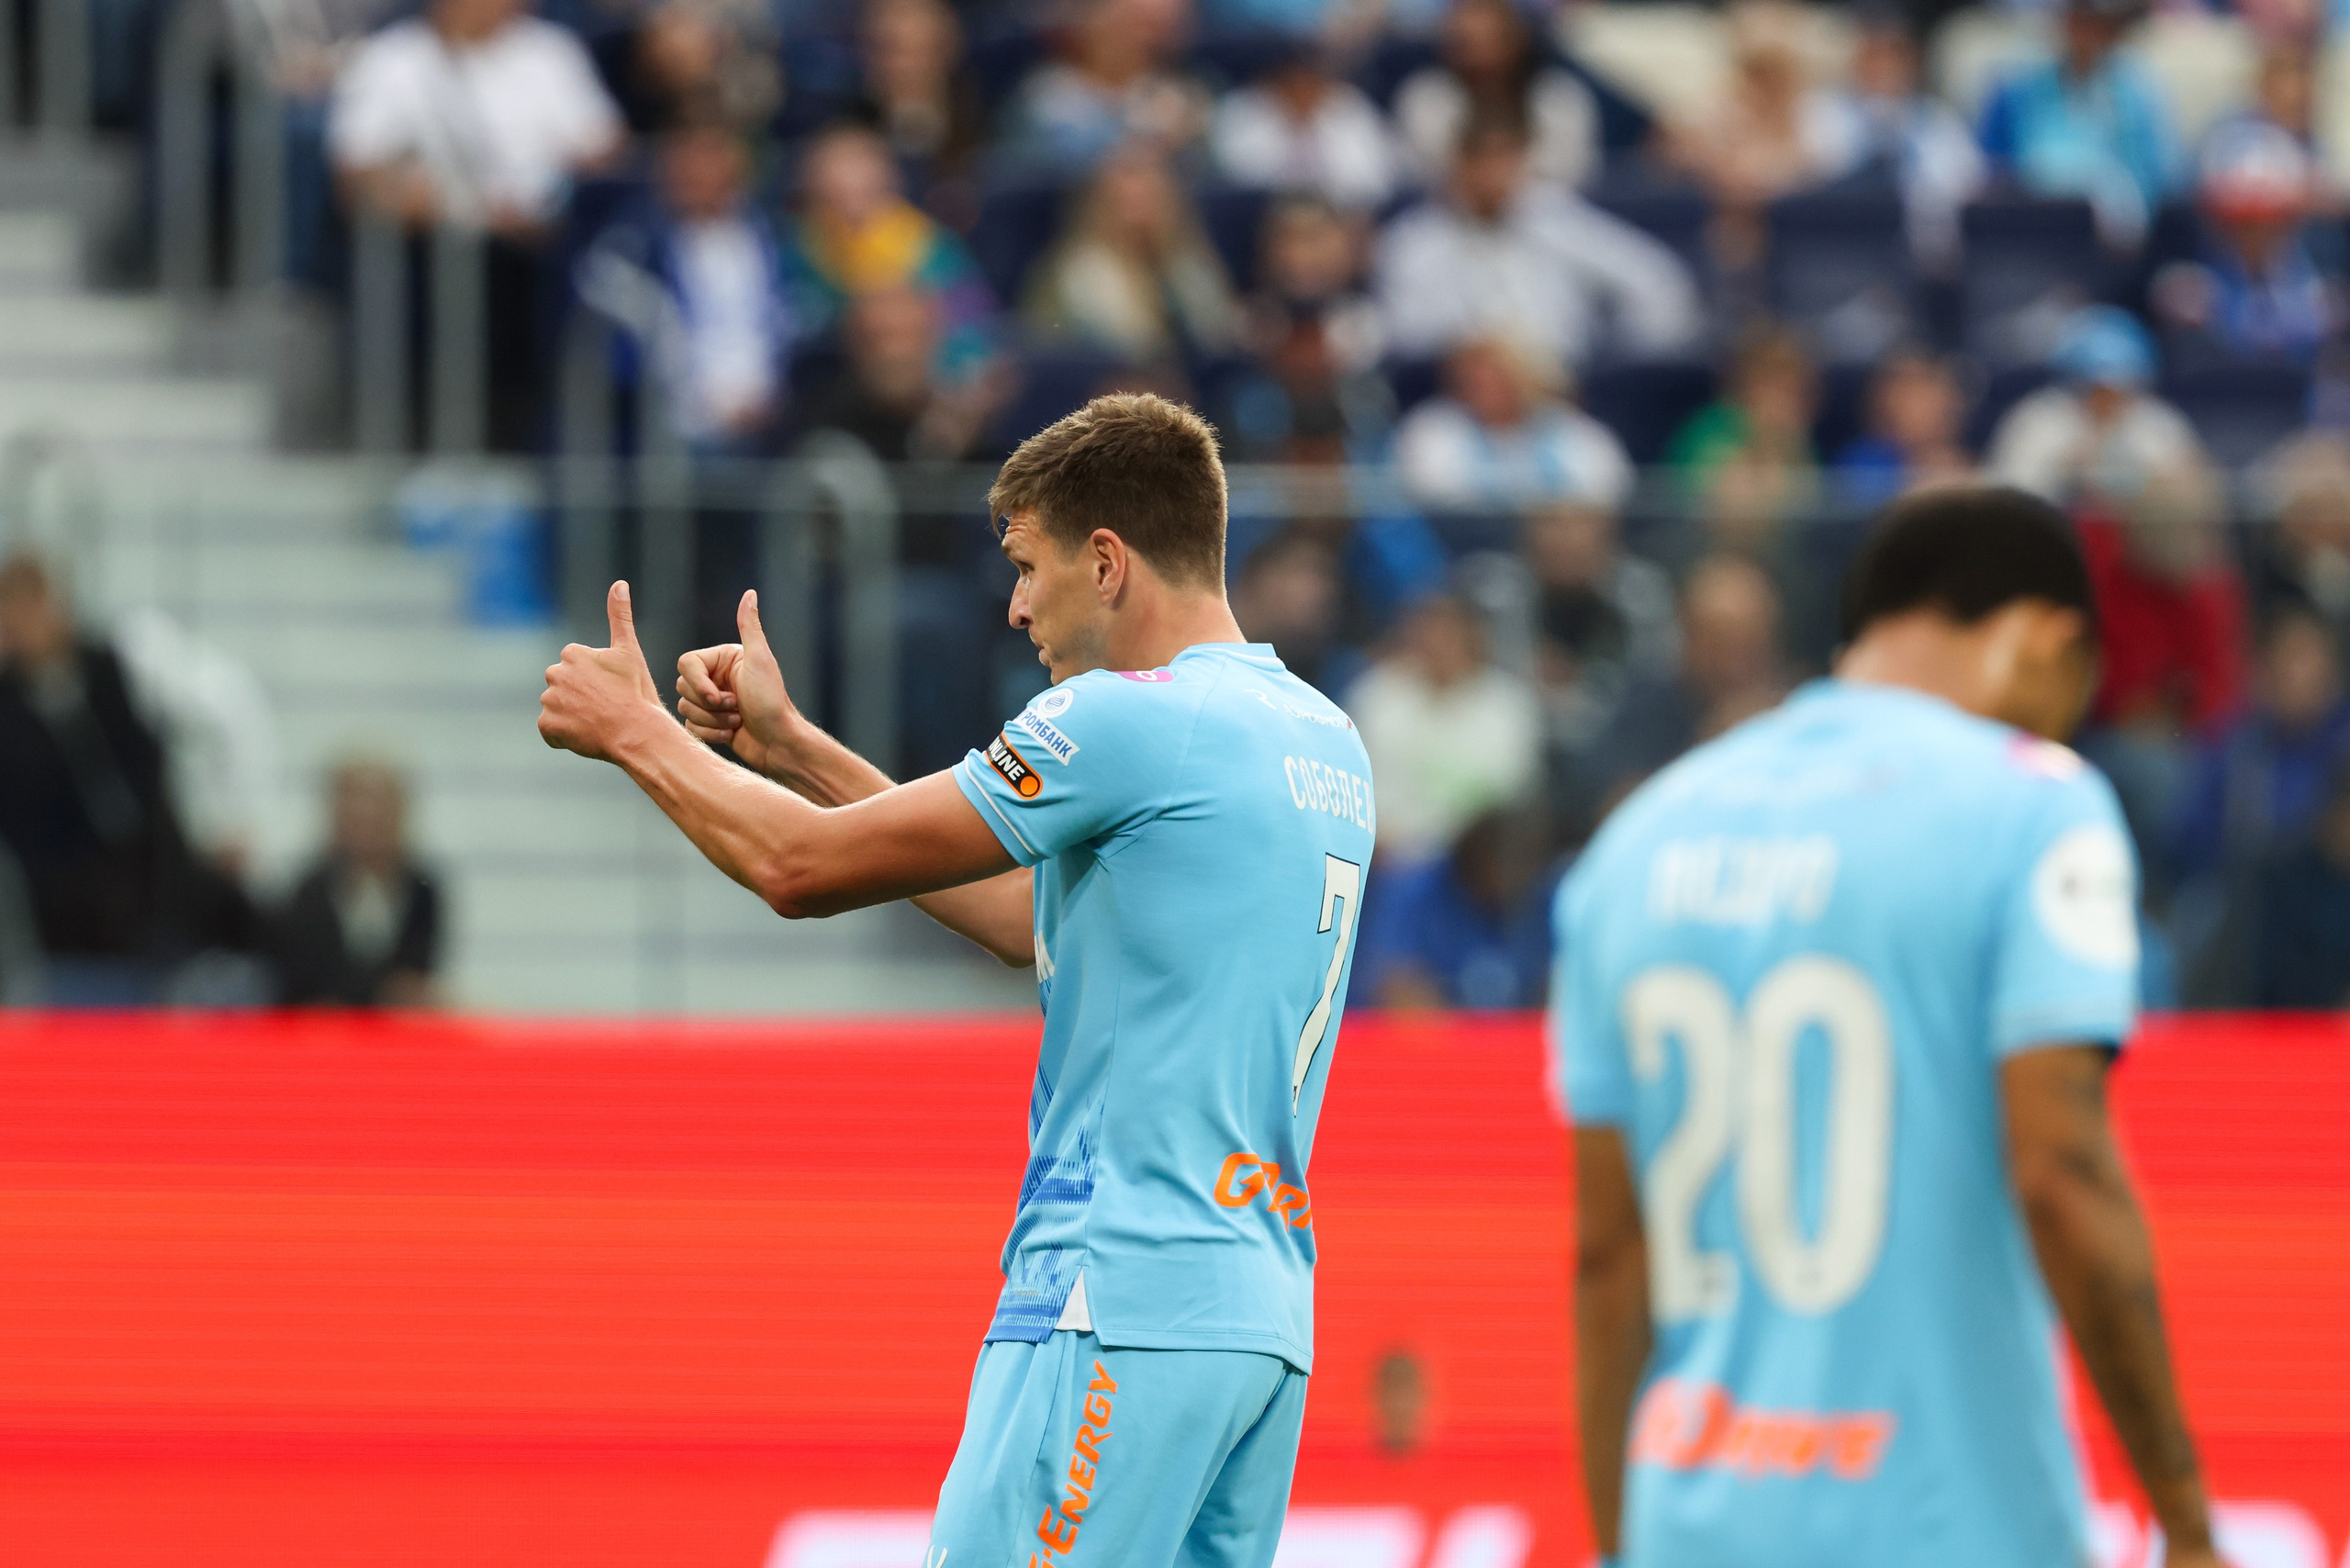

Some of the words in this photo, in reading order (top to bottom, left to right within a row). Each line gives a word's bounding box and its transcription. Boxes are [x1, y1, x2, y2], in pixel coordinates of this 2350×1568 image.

[1017, 710, 1072, 757] РОМБАНК
[1292, 852, 1360, 1118] 7
[1622, 956, 1893, 1323] 20
